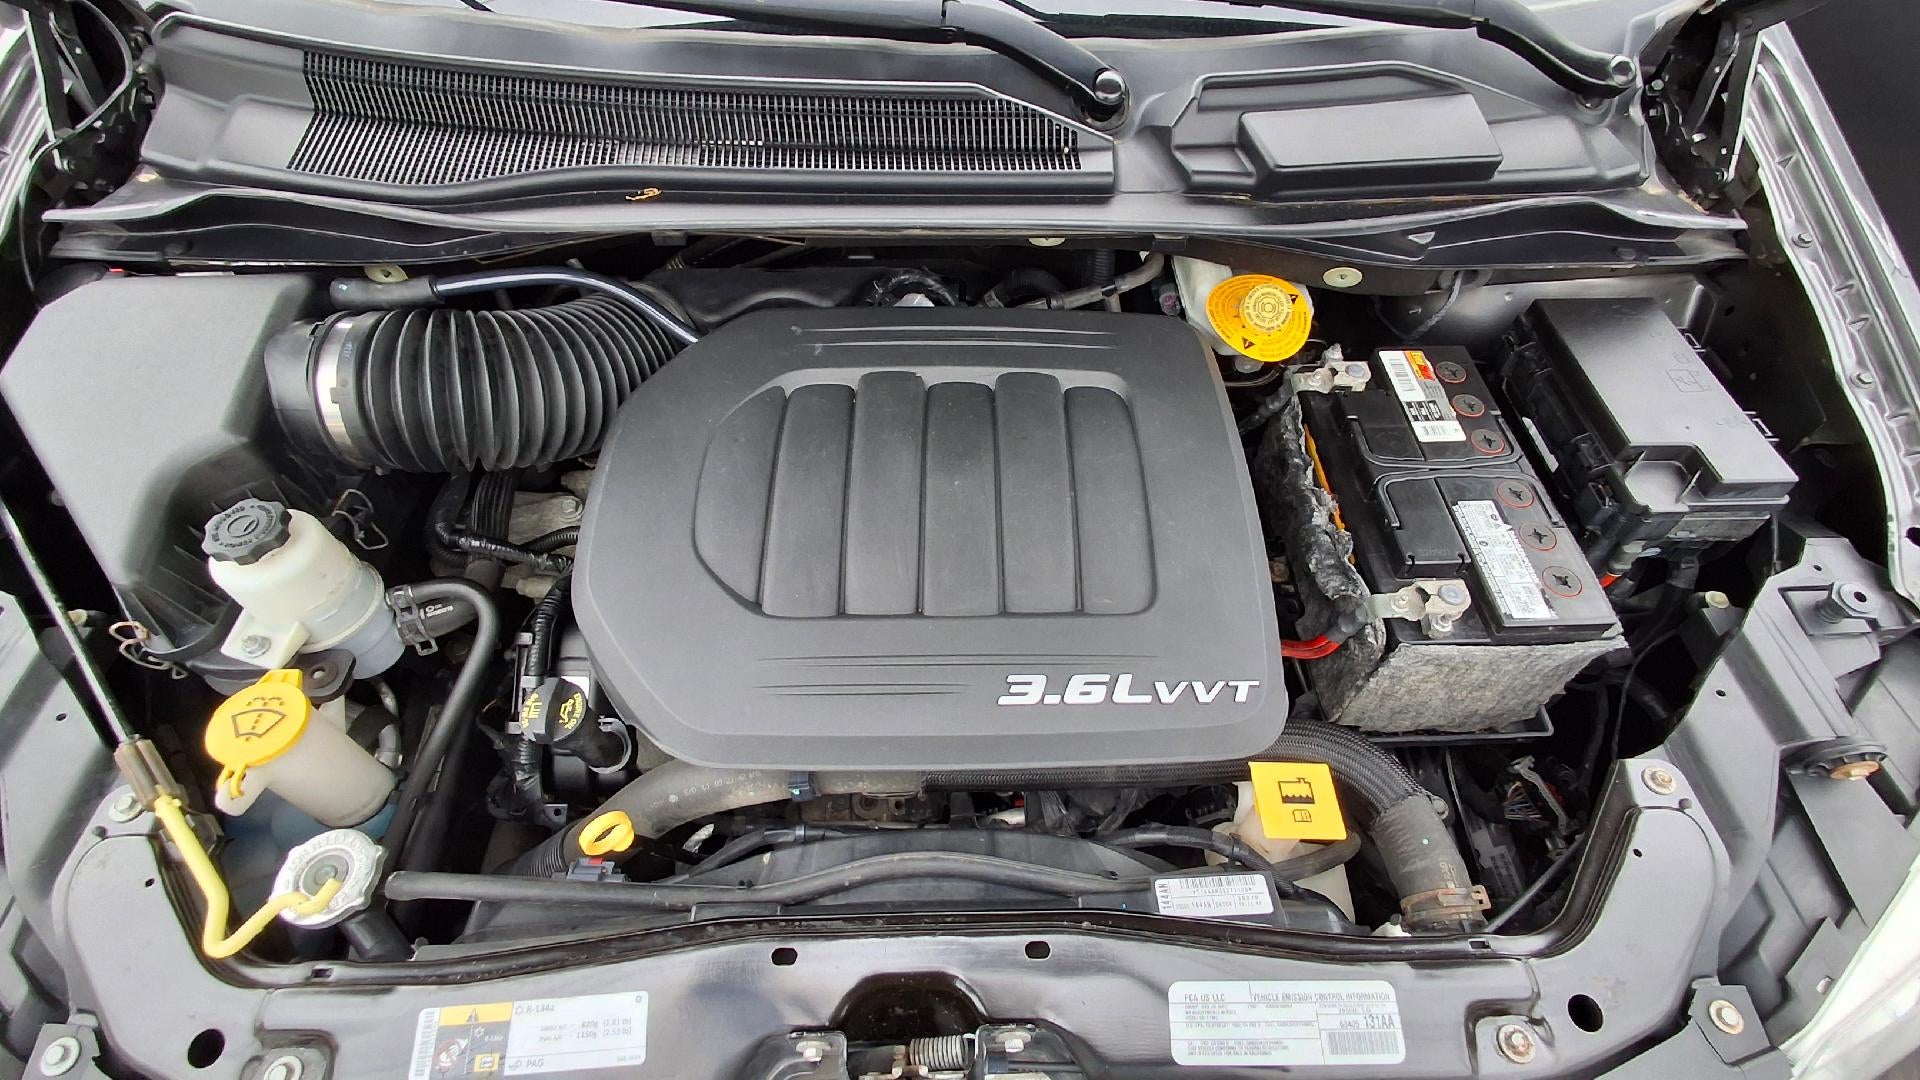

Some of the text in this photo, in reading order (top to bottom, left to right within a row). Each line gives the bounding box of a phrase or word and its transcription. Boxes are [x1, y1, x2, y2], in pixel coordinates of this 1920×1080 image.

[997, 673, 1260, 706] 3.6L VVT
[1184, 993, 1225, 1002] FCA US LLC
[1252, 992, 1390, 1002] VEHICLE EMISSION CONTROL INFORMATION
[1364, 1014, 1395, 1029] 131AA
[526, 1058, 544, 1068] PAG
